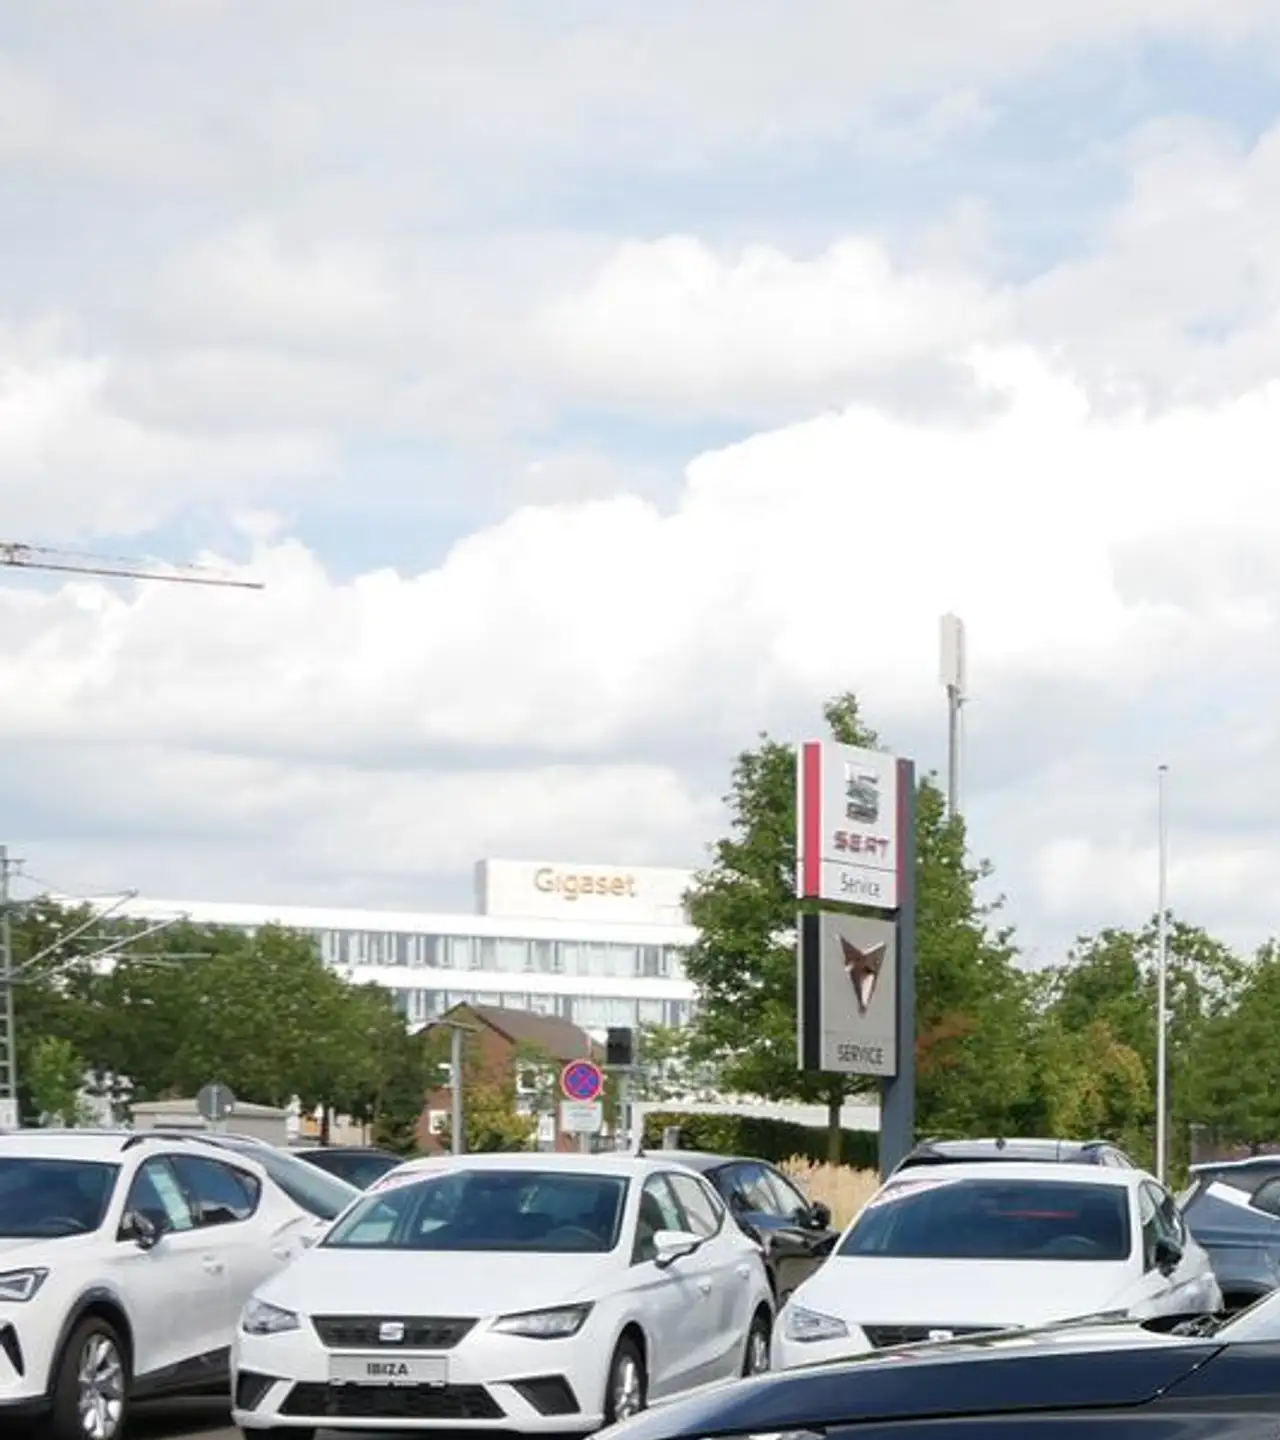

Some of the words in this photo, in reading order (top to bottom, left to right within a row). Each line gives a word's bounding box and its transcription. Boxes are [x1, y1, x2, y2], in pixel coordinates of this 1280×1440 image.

[834, 830, 889, 857] SEAT
[534, 868, 638, 901] Gigaset
[840, 872, 882, 898] Service
[837, 1044, 884, 1065] SERVICE
[367, 1363, 408, 1376] IBIZA
